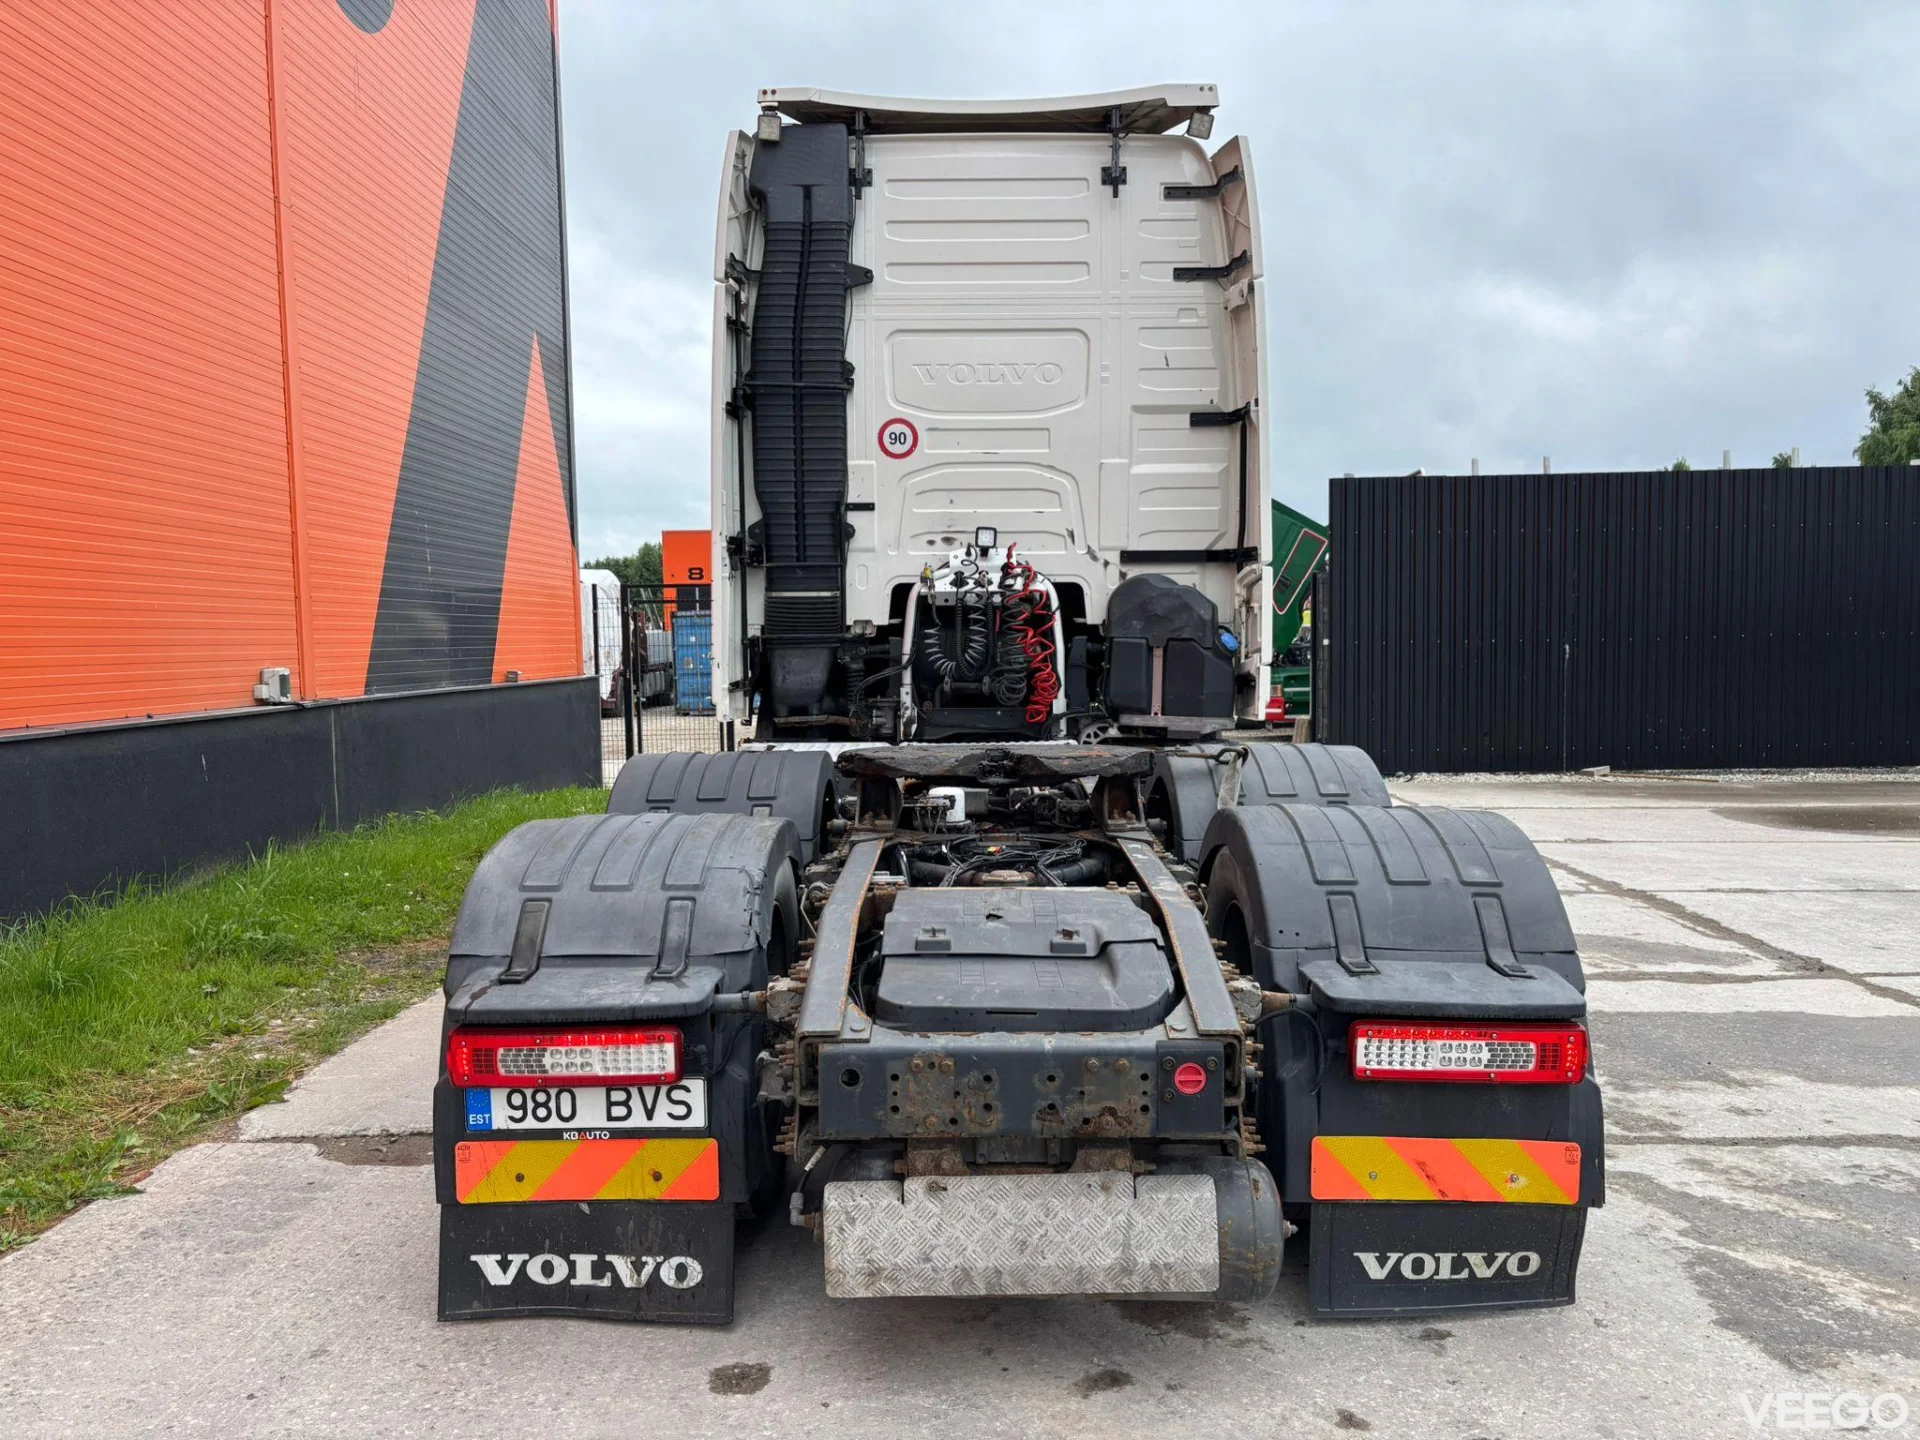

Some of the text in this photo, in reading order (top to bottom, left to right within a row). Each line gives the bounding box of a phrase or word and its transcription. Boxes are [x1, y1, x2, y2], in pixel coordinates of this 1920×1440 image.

[910, 362, 1064, 386] VOLVO
[888, 431, 907, 445] 90
[688, 567, 704, 581] 8
[505, 1084, 693, 1124] 980 BVS
[469, 1114, 491, 1125] EST
[470, 1254, 703, 1289] VOLVO
[1353, 1251, 1541, 1280] VOLVO
